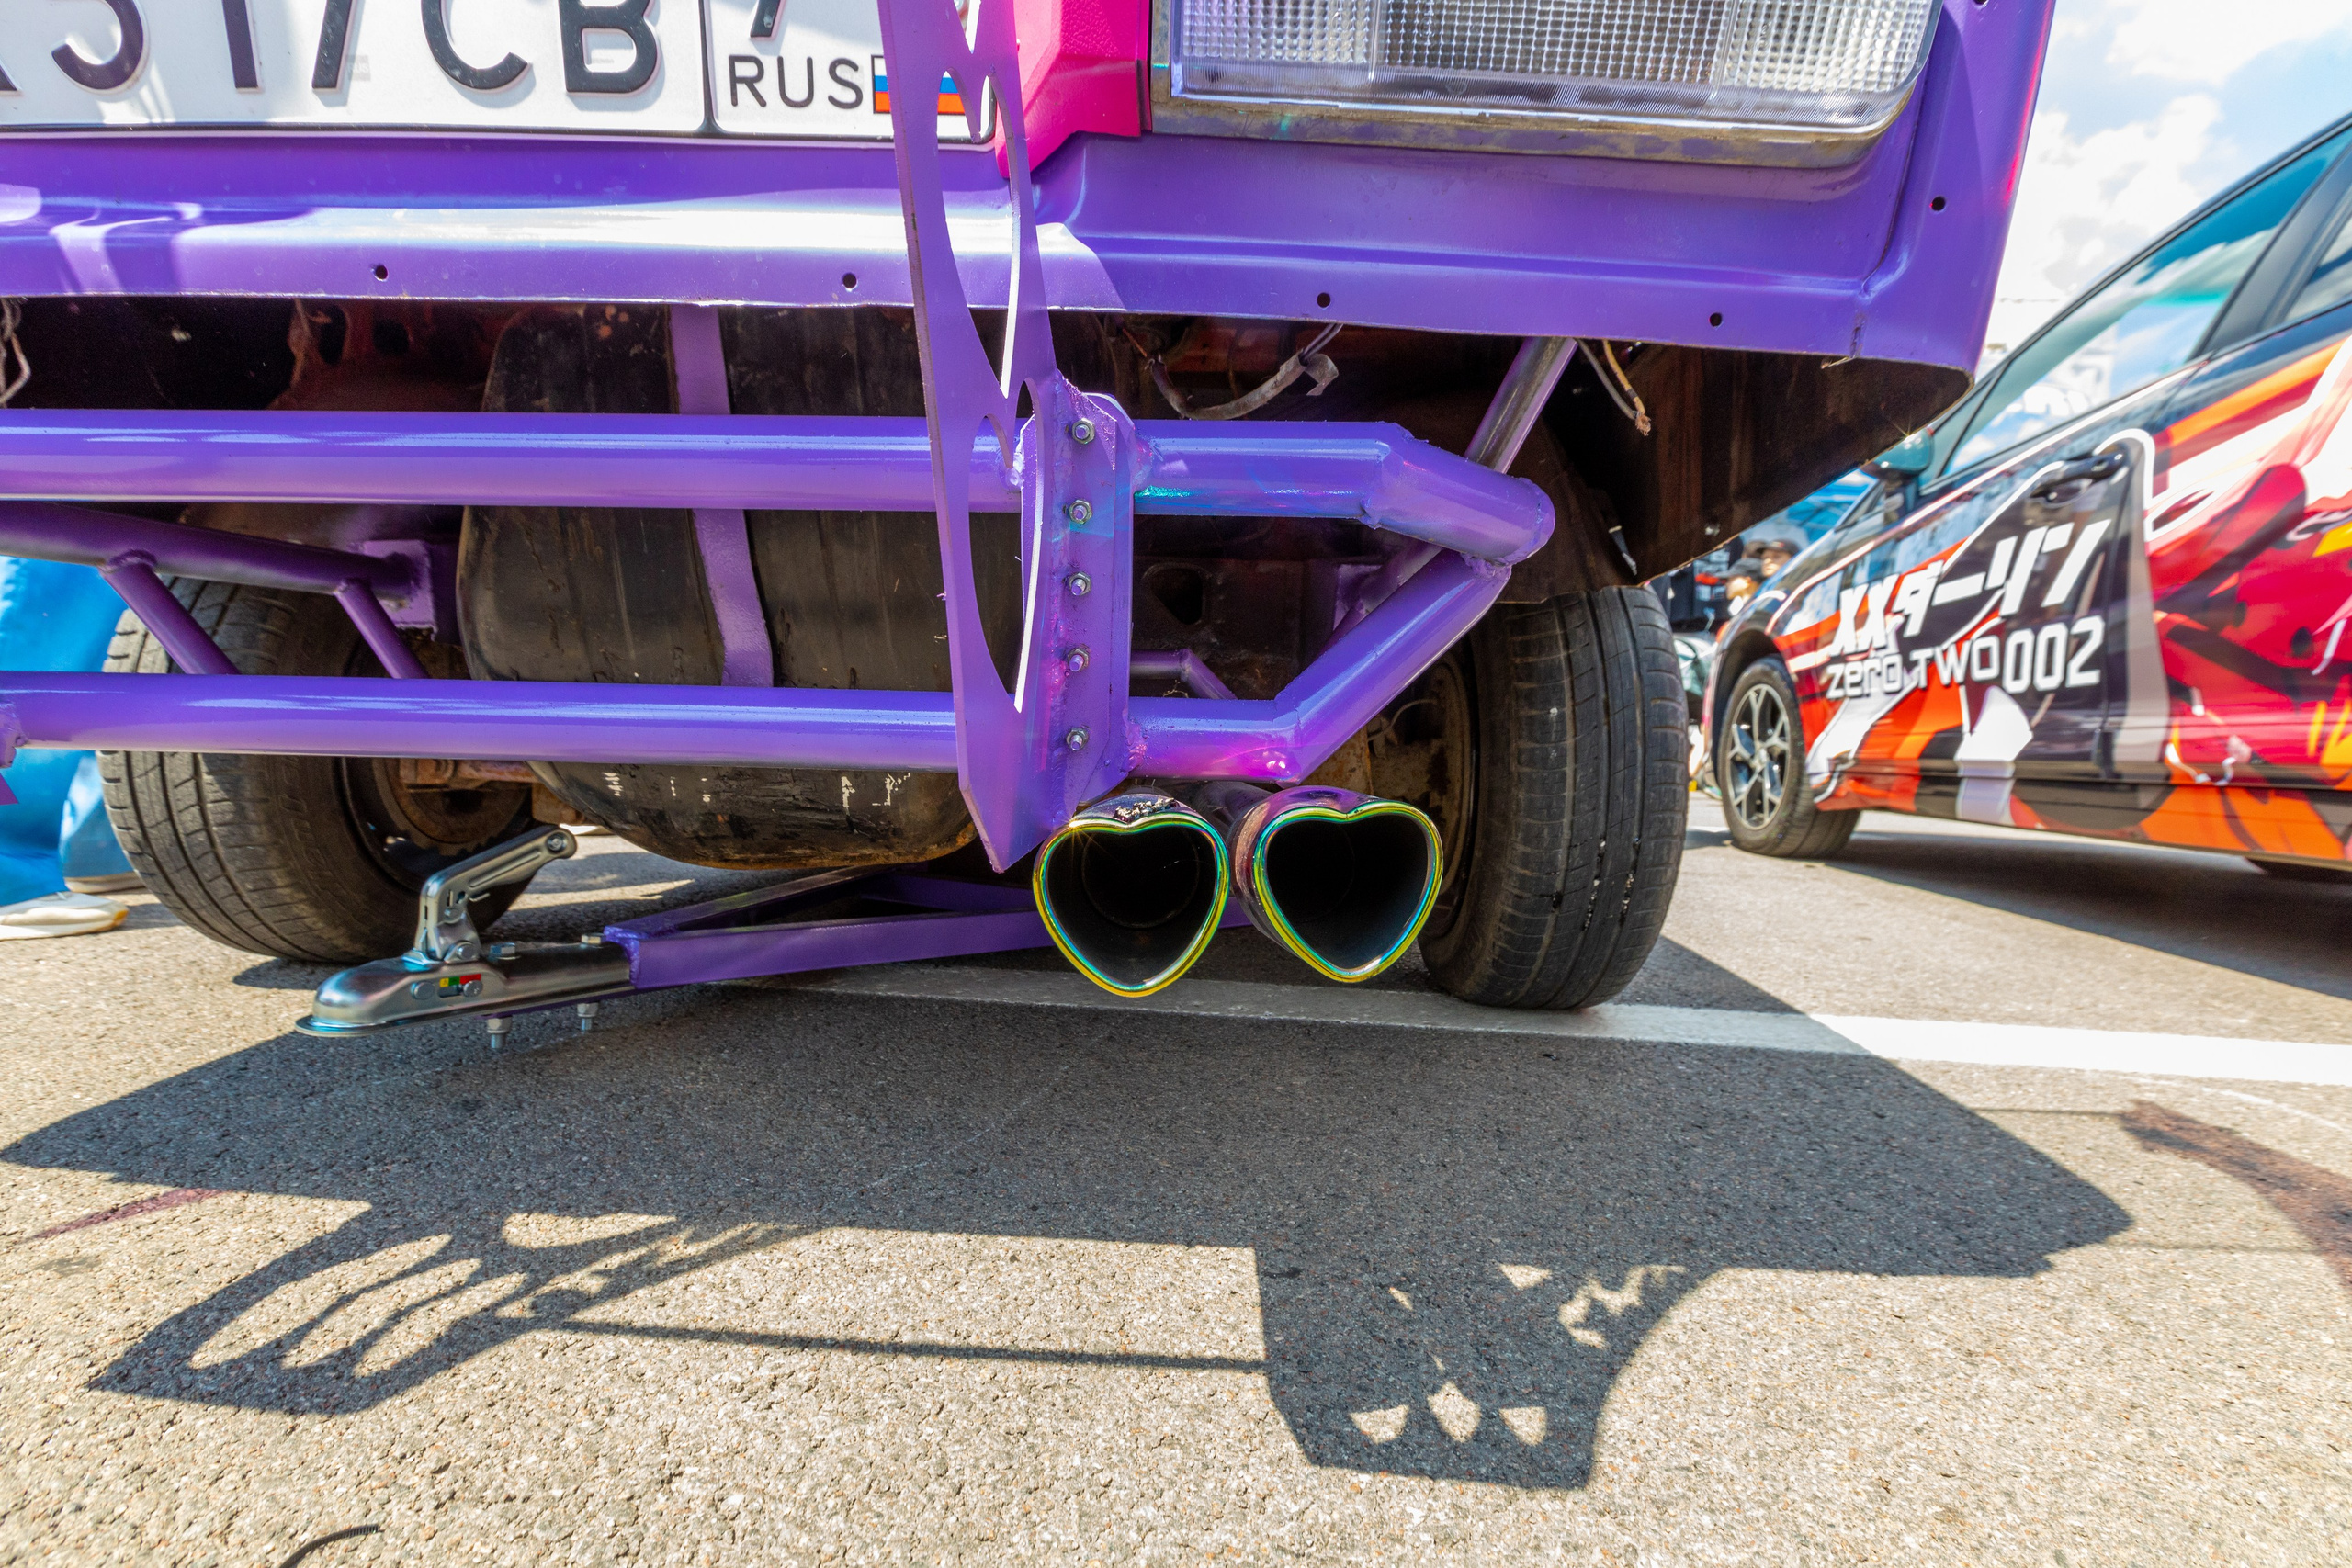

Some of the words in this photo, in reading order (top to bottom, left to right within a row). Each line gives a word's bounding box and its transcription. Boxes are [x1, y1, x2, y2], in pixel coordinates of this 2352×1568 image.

[729, 54, 864, 108] RUS
[1909, 635, 2000, 689] TWO
[2002, 615, 2105, 694] 002
